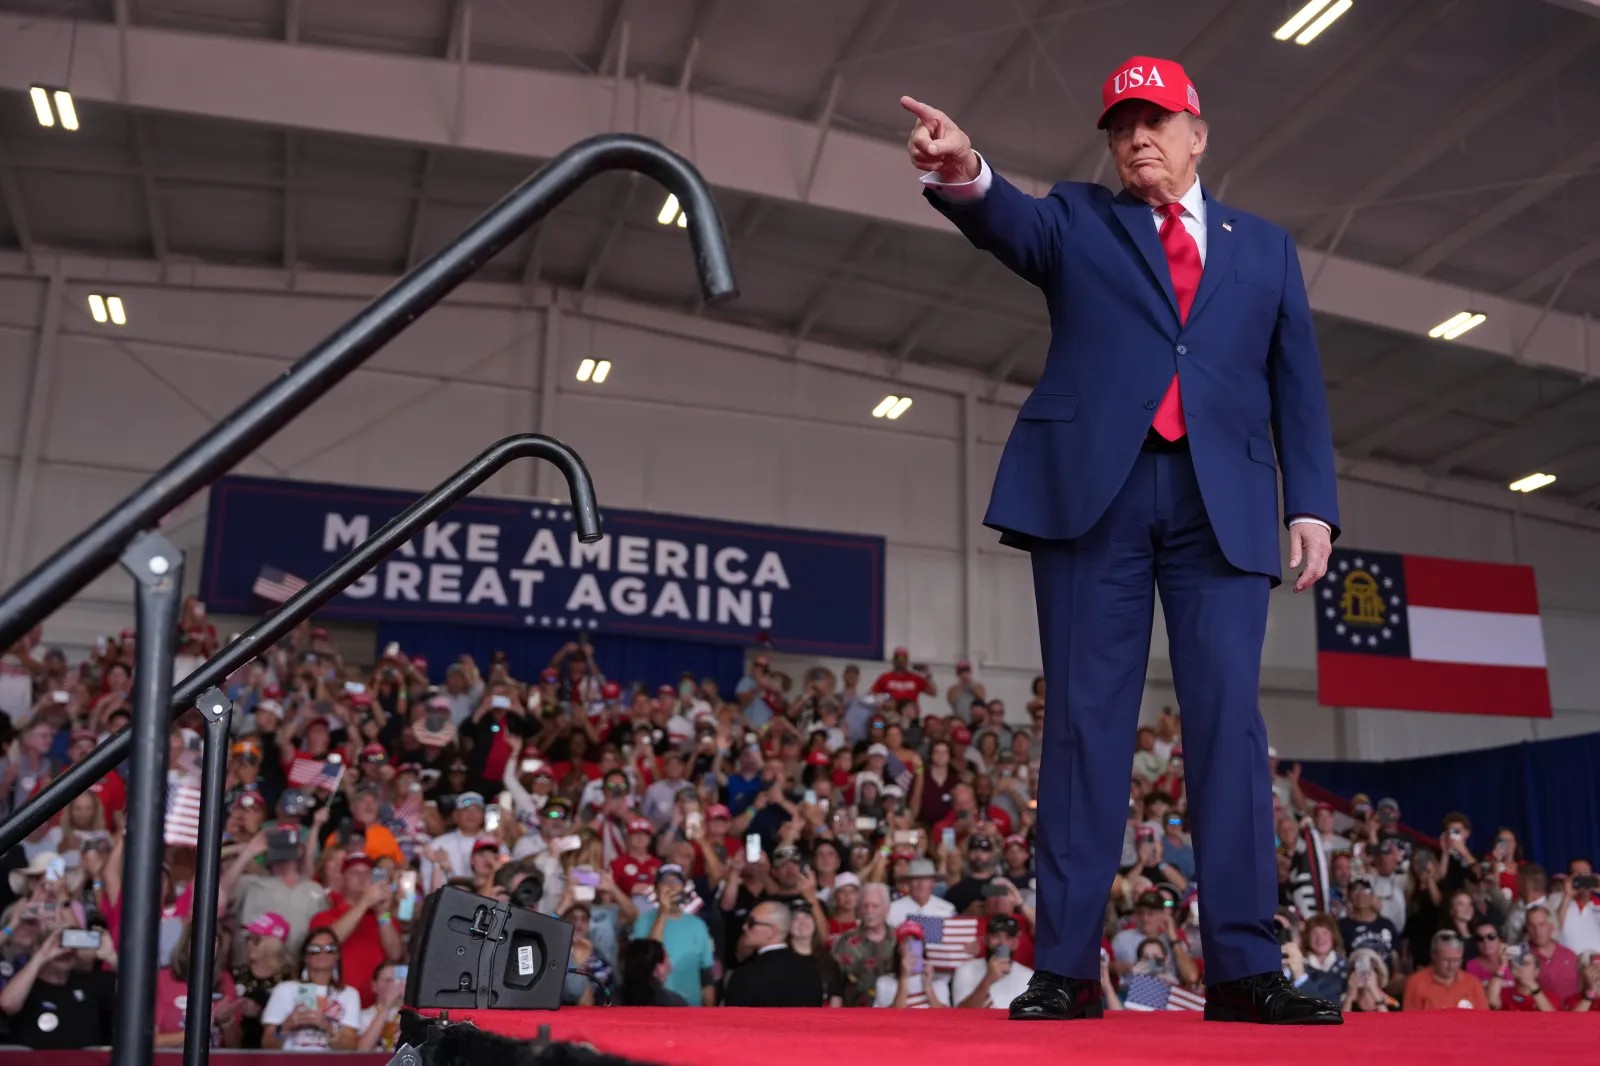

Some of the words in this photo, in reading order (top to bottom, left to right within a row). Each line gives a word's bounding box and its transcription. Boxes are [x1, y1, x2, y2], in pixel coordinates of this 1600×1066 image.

[1113, 65, 1165, 94] USA
[323, 511, 500, 563] MKE
[522, 527, 791, 589] AMERICA
[565, 572, 774, 629] AGAIN!
